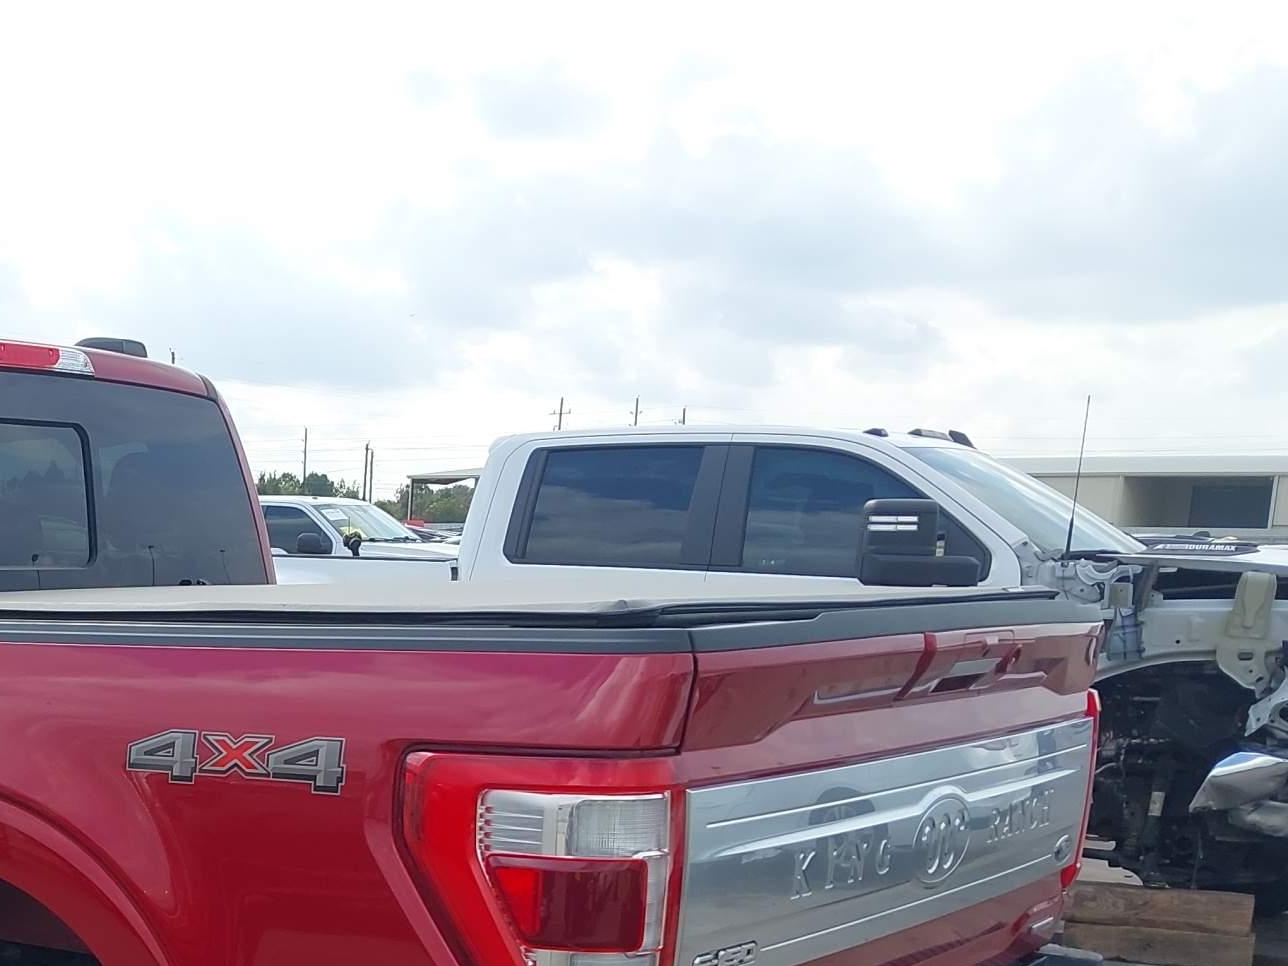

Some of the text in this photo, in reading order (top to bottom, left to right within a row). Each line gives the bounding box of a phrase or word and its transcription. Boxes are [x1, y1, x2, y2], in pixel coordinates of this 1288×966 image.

[1187, 543, 1237, 552] DURAMAX
[790, 789, 1055, 900] KING RANCH
